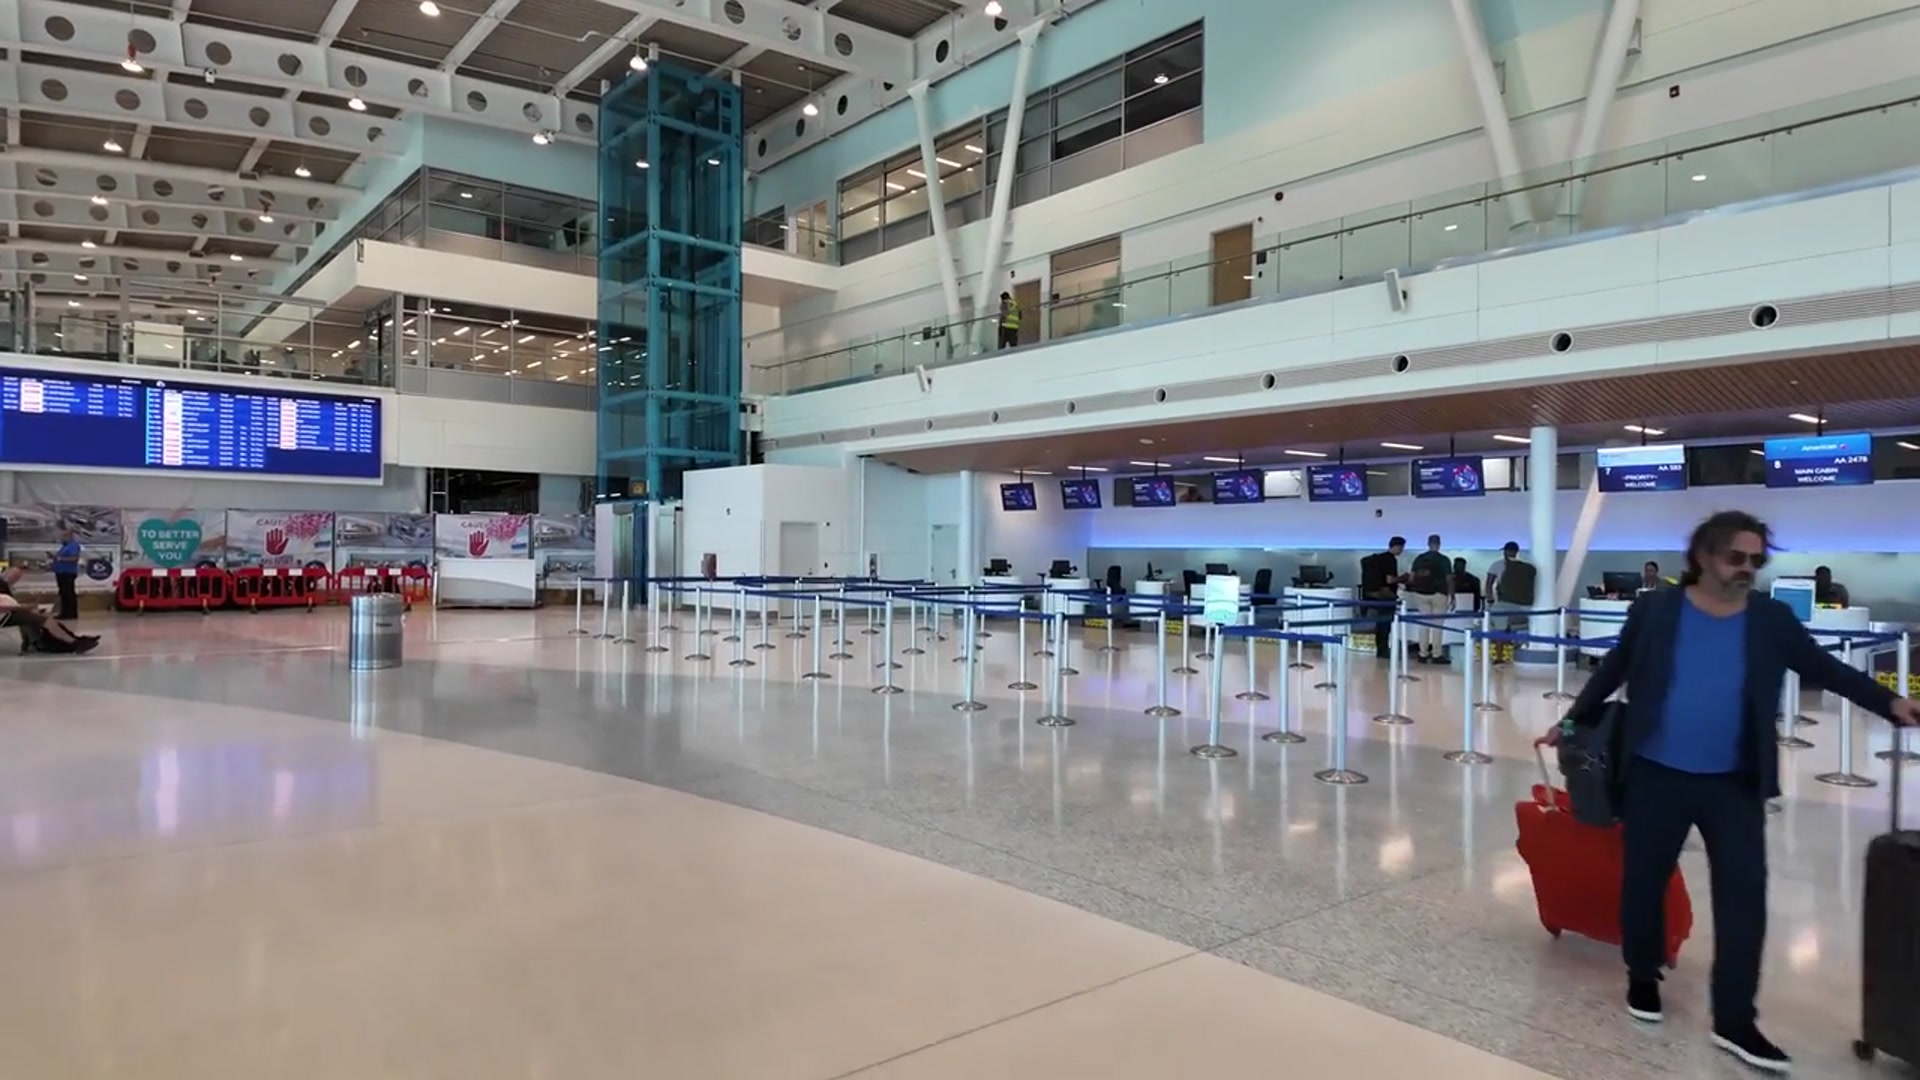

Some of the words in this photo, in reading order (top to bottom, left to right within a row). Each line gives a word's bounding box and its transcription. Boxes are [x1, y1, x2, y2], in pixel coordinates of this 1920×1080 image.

[1605, 467, 1611, 475] 7
[1658, 464, 1669, 472] AA
[1794, 467, 1814, 475] MAIN
[1814, 466, 1839, 475] CABIN
[1797, 475, 1836, 483] WELCOME
[1624, 481, 1656, 489] WELCOME
[141, 529, 157, 539] TO
[158, 530, 200, 539] BETTER
[153, 540, 188, 550] SERVE
[158, 550, 183, 560] YOU
